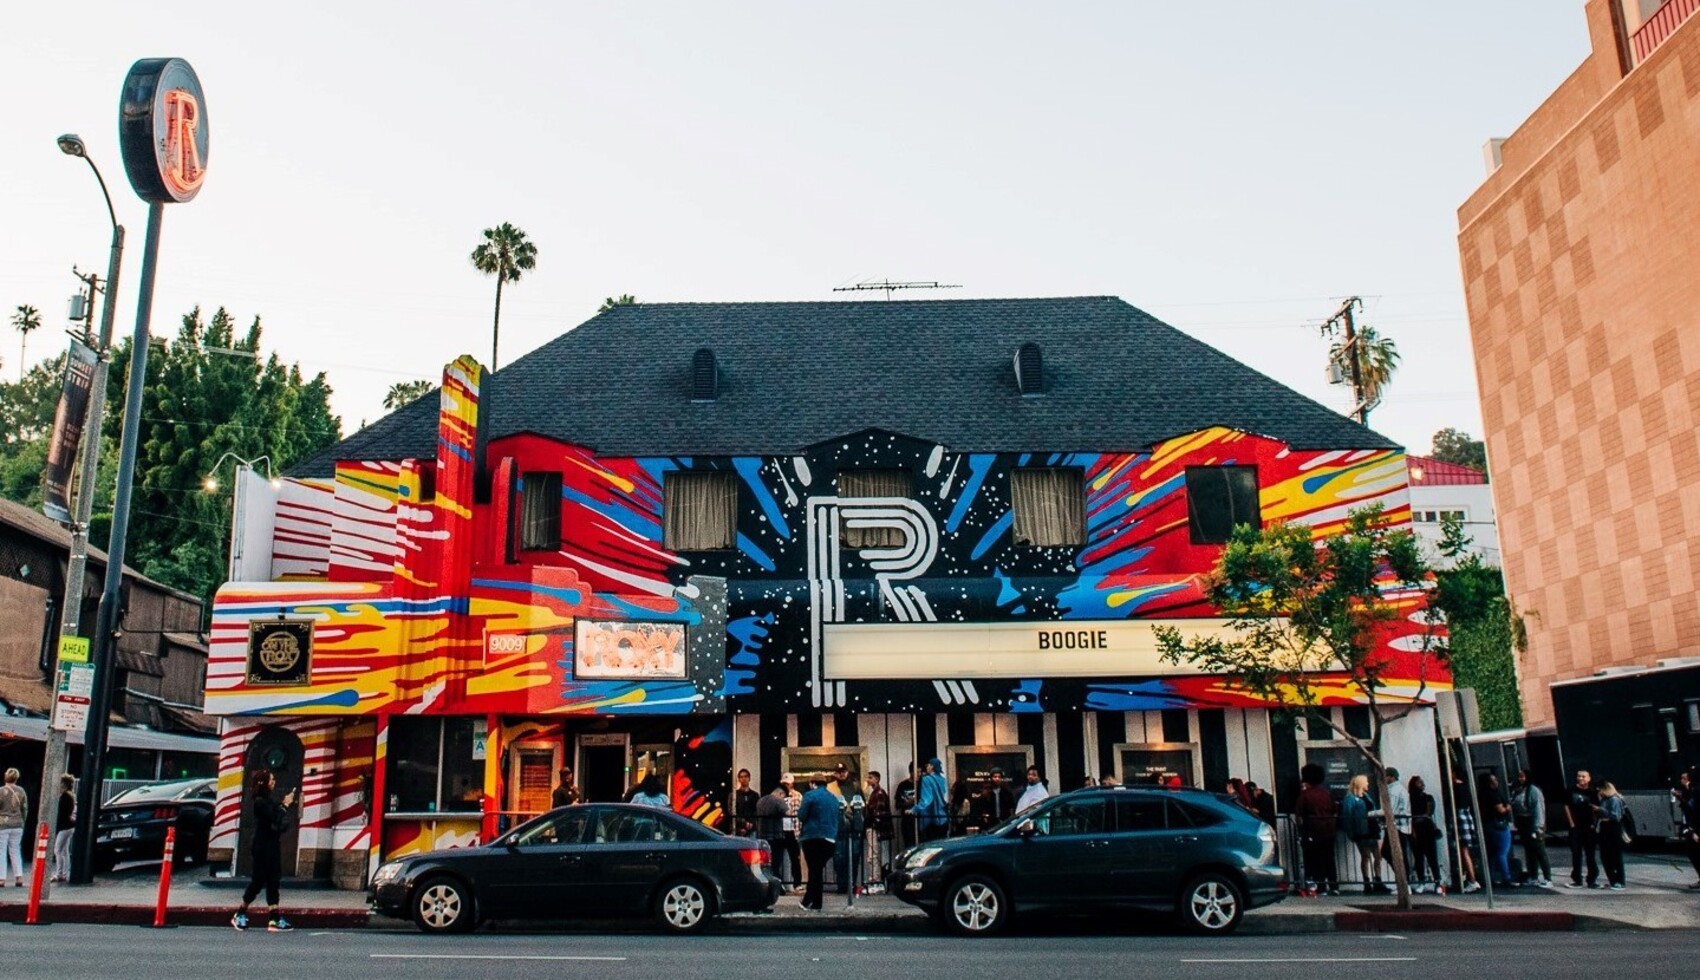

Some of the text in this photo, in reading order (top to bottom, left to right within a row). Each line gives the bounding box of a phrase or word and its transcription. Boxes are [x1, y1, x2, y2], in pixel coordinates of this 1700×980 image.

[164, 89, 205, 192] R
[70, 357, 92, 376] SUNSET
[67, 372, 89, 389] STRIP
[807, 496, 979, 708] R
[491, 637, 523, 651] 9009
[584, 628, 681, 668] ROXY
[1038, 630, 1108, 649] BOOGIE
[63, 643, 87, 656] AHEAD
[61, 709, 84, 717] STOPPING
[475, 740, 485, 751] A
